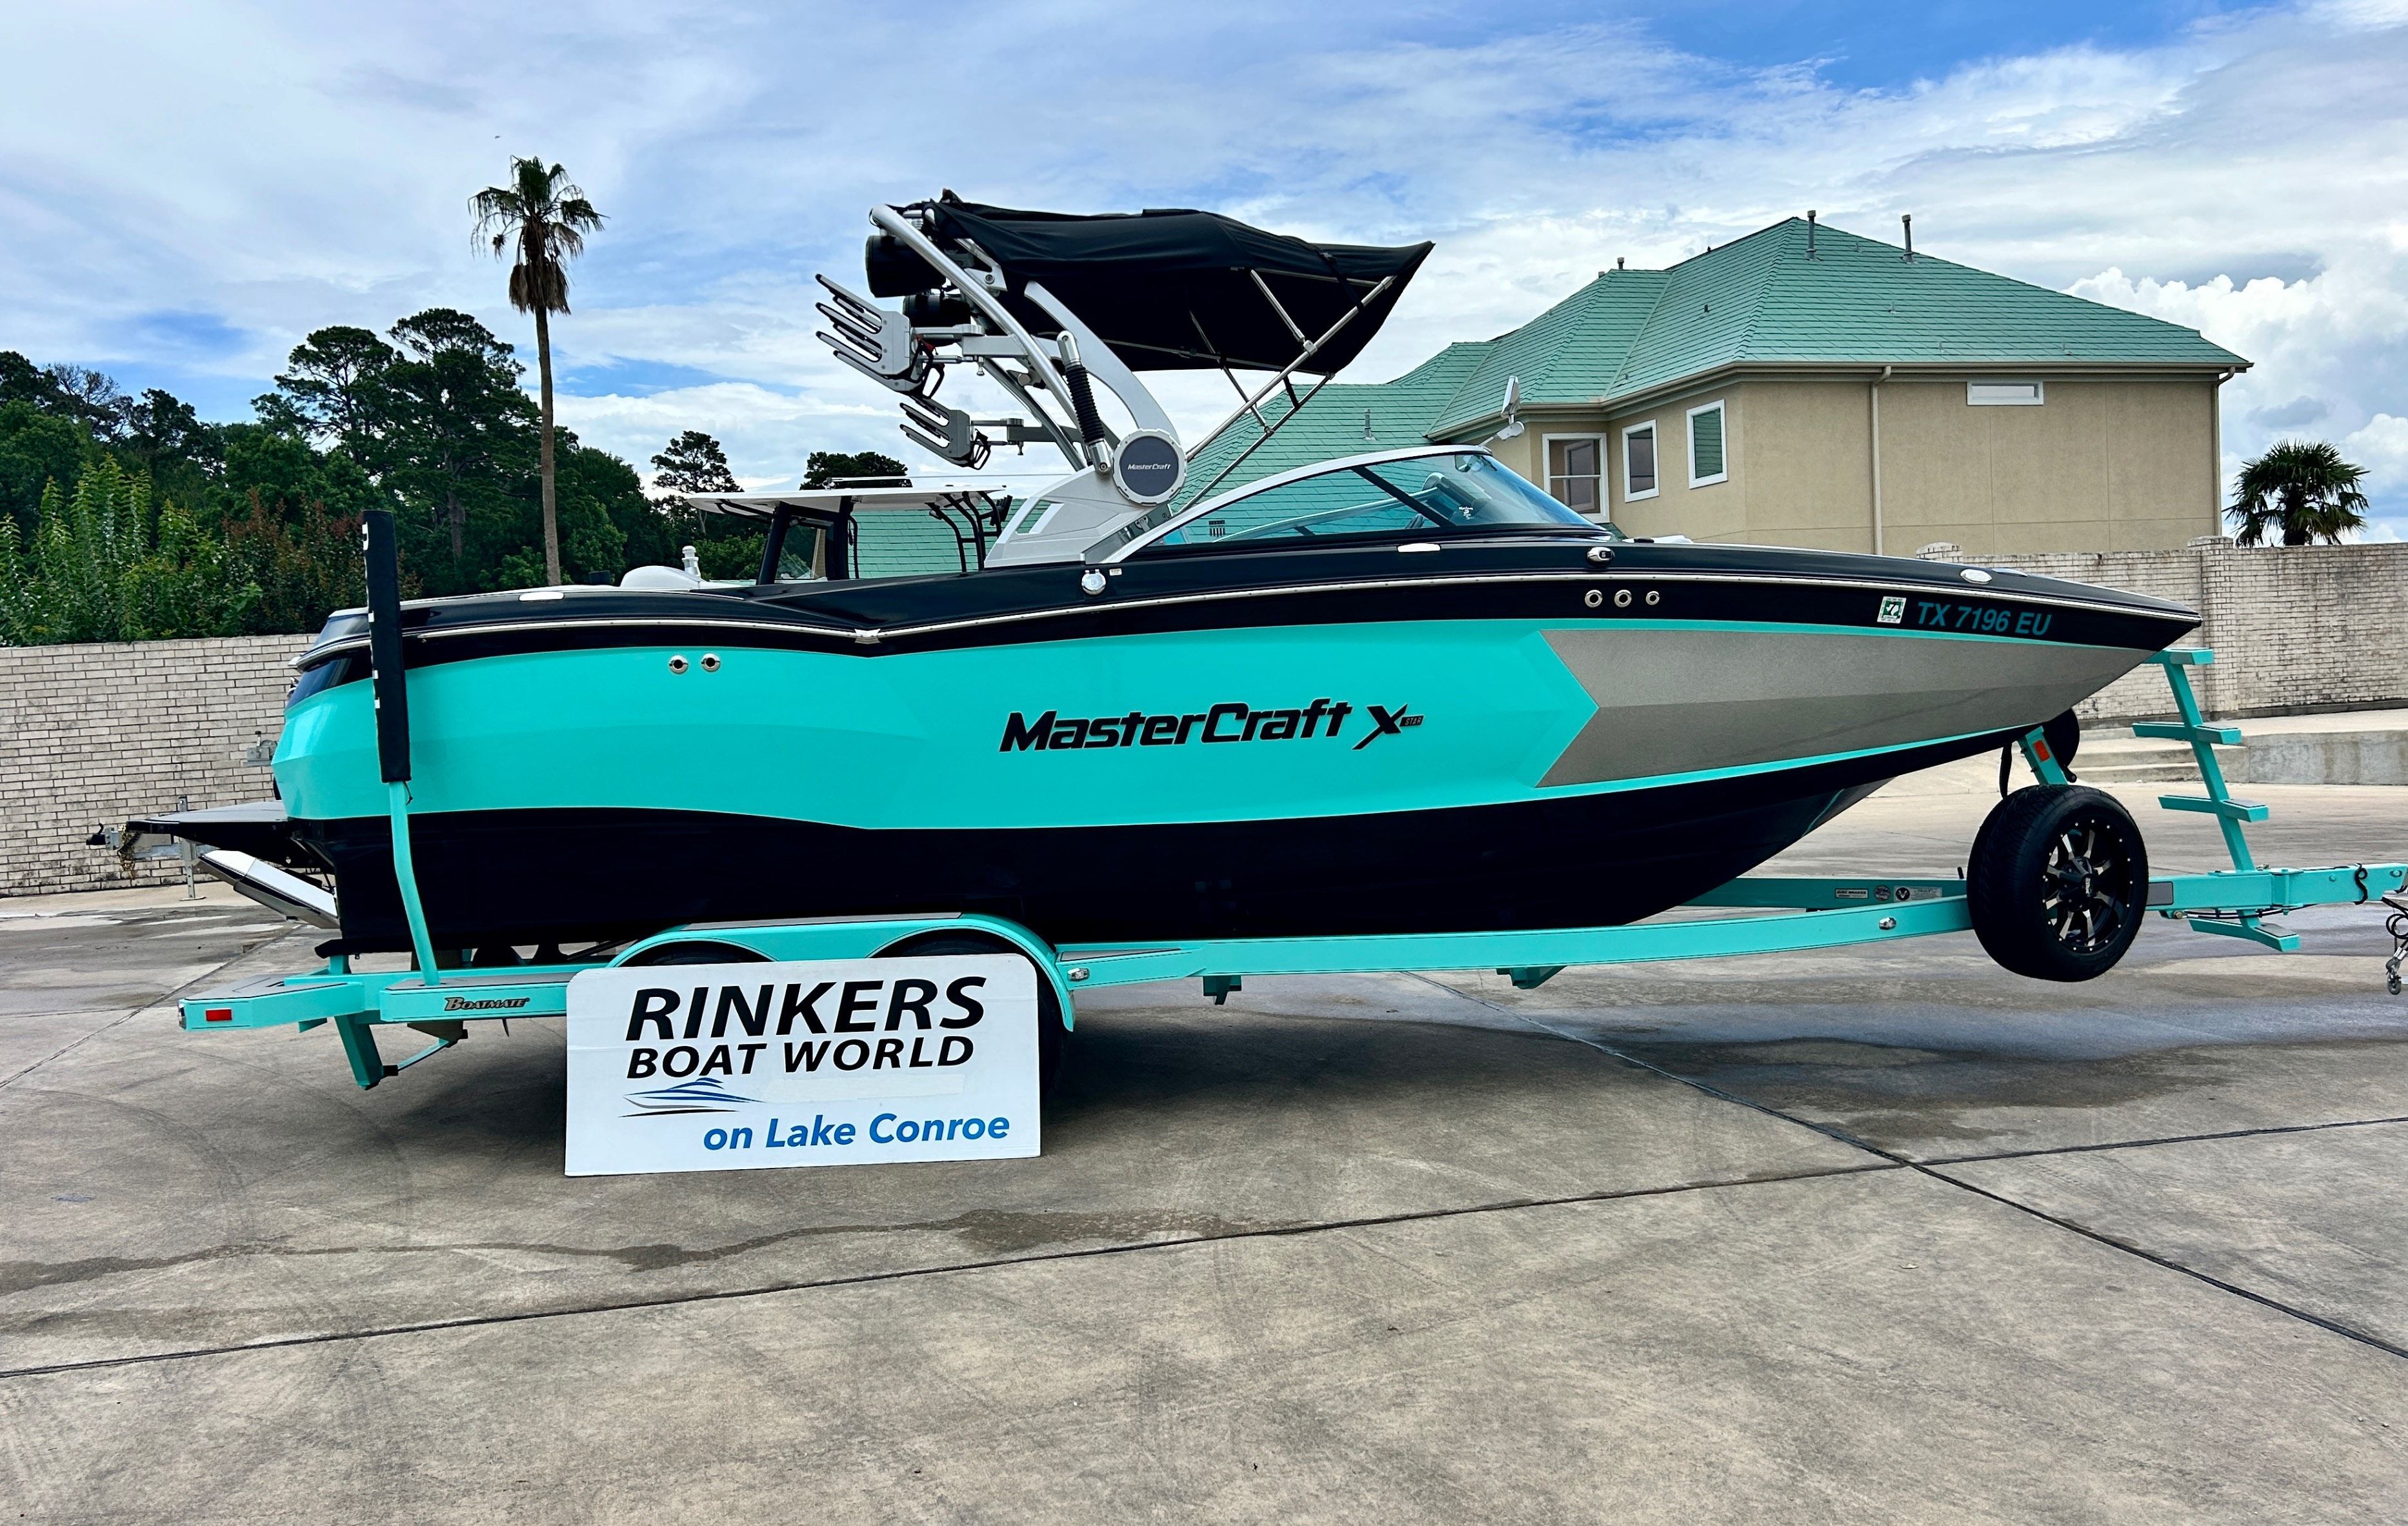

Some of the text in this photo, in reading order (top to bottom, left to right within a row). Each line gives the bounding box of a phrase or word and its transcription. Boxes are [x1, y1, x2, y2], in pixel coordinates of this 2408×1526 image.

[1918, 601, 2052, 636] TX 7196 EU
[999, 698, 1354, 752] MasterCraft
[625, 976, 987, 1041] RINKERS
[627, 1036, 974, 1079] BOAT WORLD
[703, 1112, 1010, 1151] on Lake Conroe
